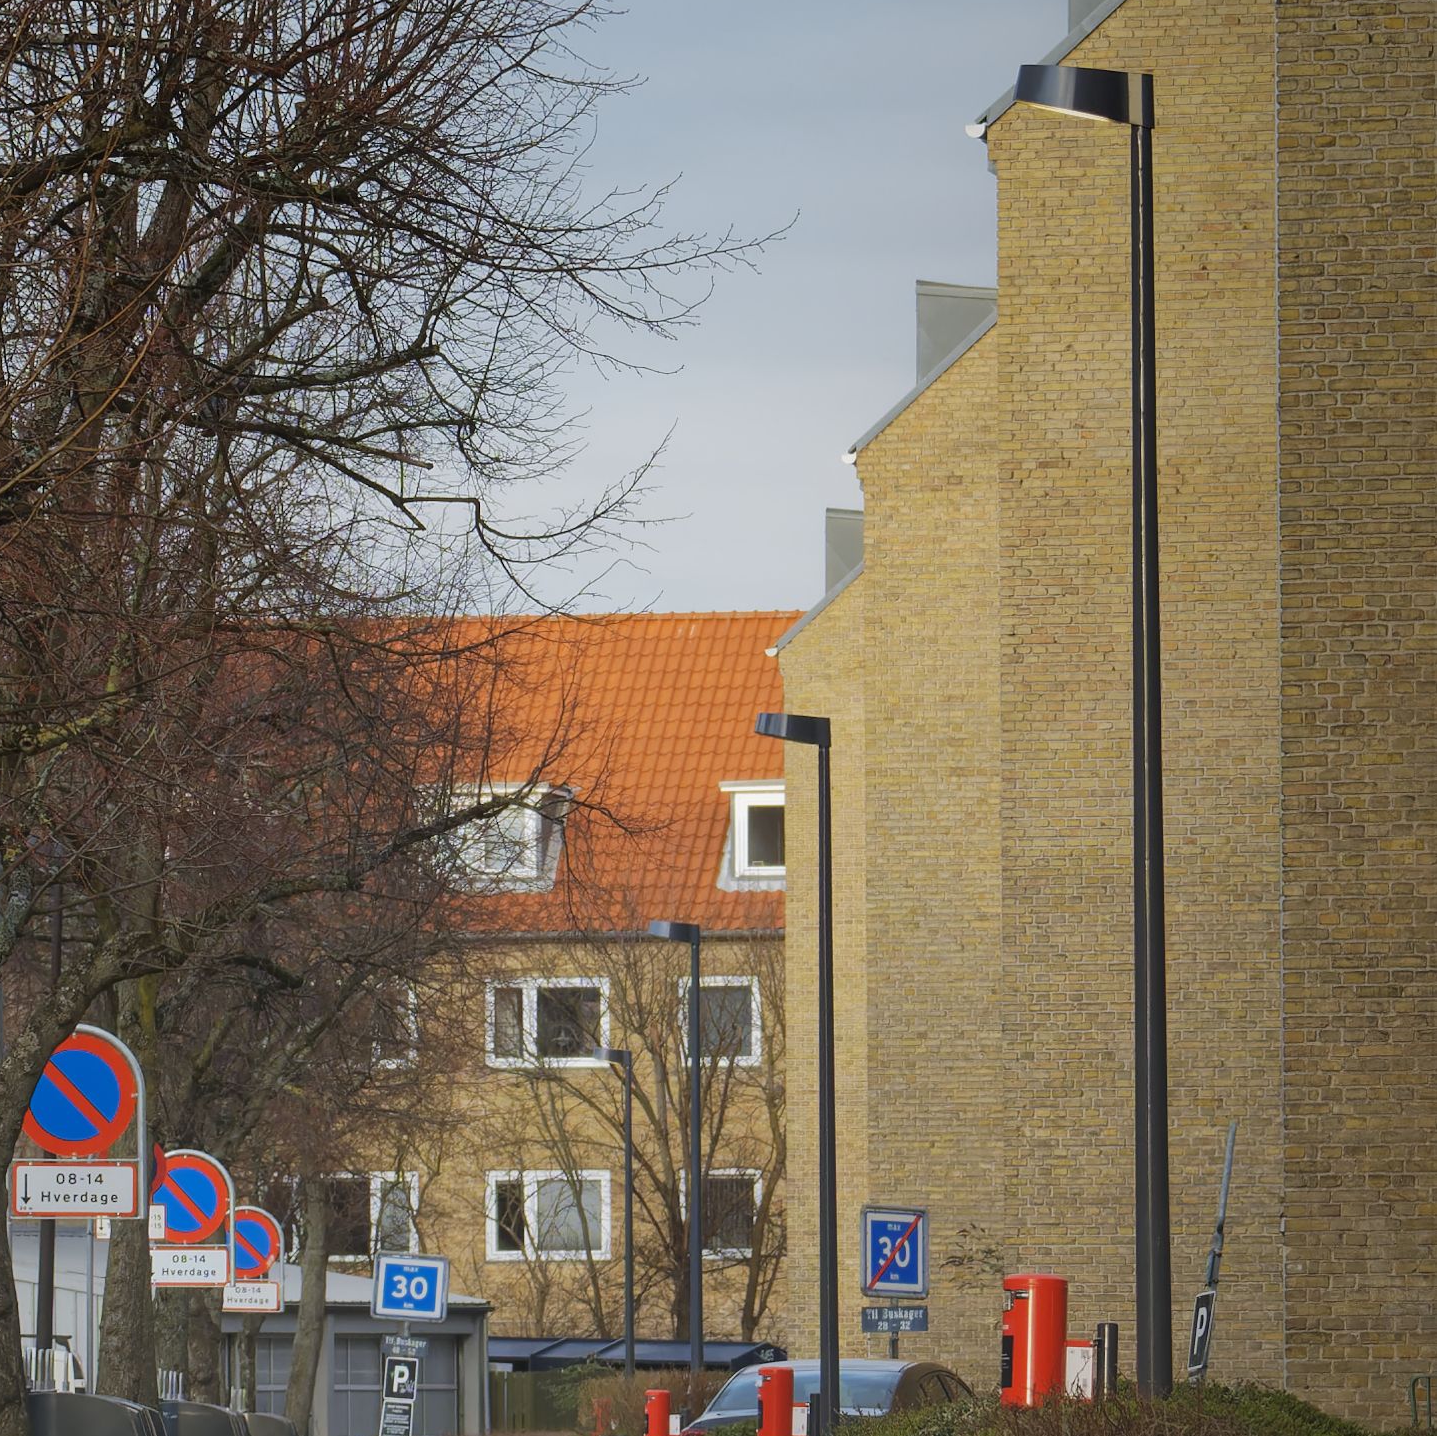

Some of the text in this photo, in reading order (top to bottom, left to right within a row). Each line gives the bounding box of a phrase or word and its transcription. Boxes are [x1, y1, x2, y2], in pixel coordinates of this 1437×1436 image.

[56, 1173, 104, 1185] 08-14
[41, 1191, 119, 1205] Hverdage
[887, 1223, 901, 1231] max
[878, 1236, 910, 1268] 30
[172, 1254, 206, 1264] 08-14
[162, 1268, 216, 1278] Hverdage
[890, 1273, 900, 1281] km
[391, 1275, 428, 1300] 30
[1194, 1307, 1207, 1355] P
[392, 1365, 410, 1393] P
